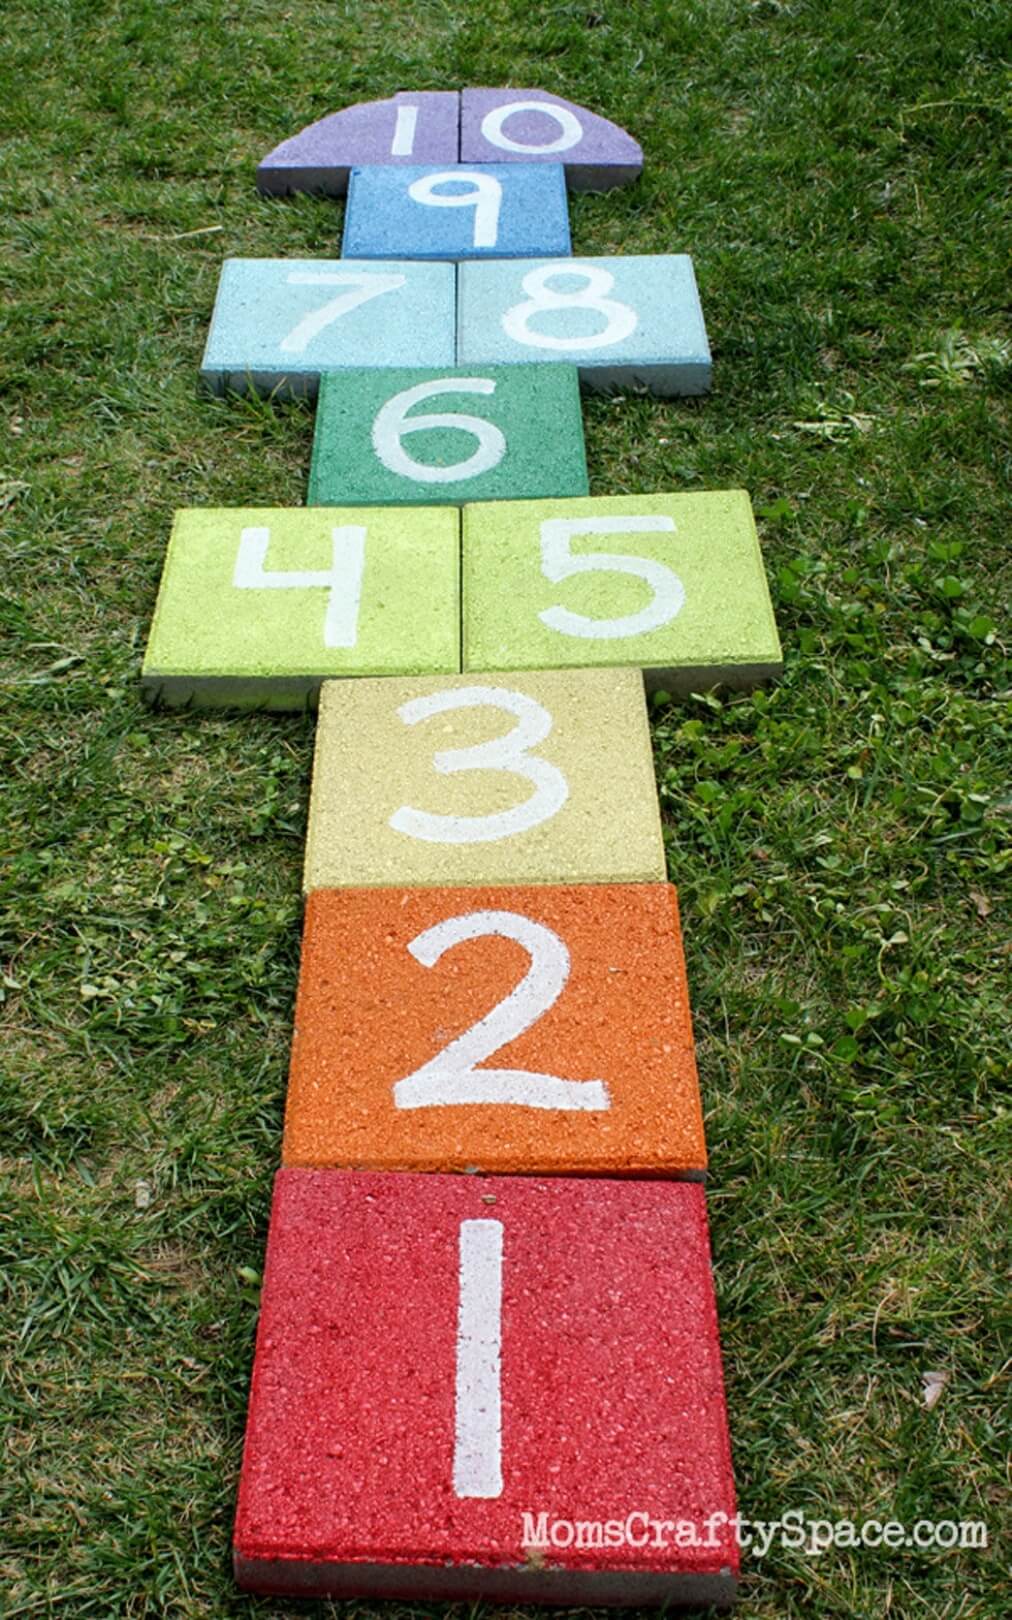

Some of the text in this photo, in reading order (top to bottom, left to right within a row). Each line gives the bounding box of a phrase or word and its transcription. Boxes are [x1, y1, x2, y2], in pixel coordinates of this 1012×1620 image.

[391, 101, 583, 155] 10
[408, 171, 502, 247] 9
[280, 272, 406, 352] 7
[502, 263, 638, 350] 8
[371, 377, 507, 483] 6
[232, 524, 367, 648] 4
[537, 515, 685, 640] 5
[388, 685, 570, 845] 3
[393, 910, 612, 1112] 2
[454, 1218, 503, 1498] 1
